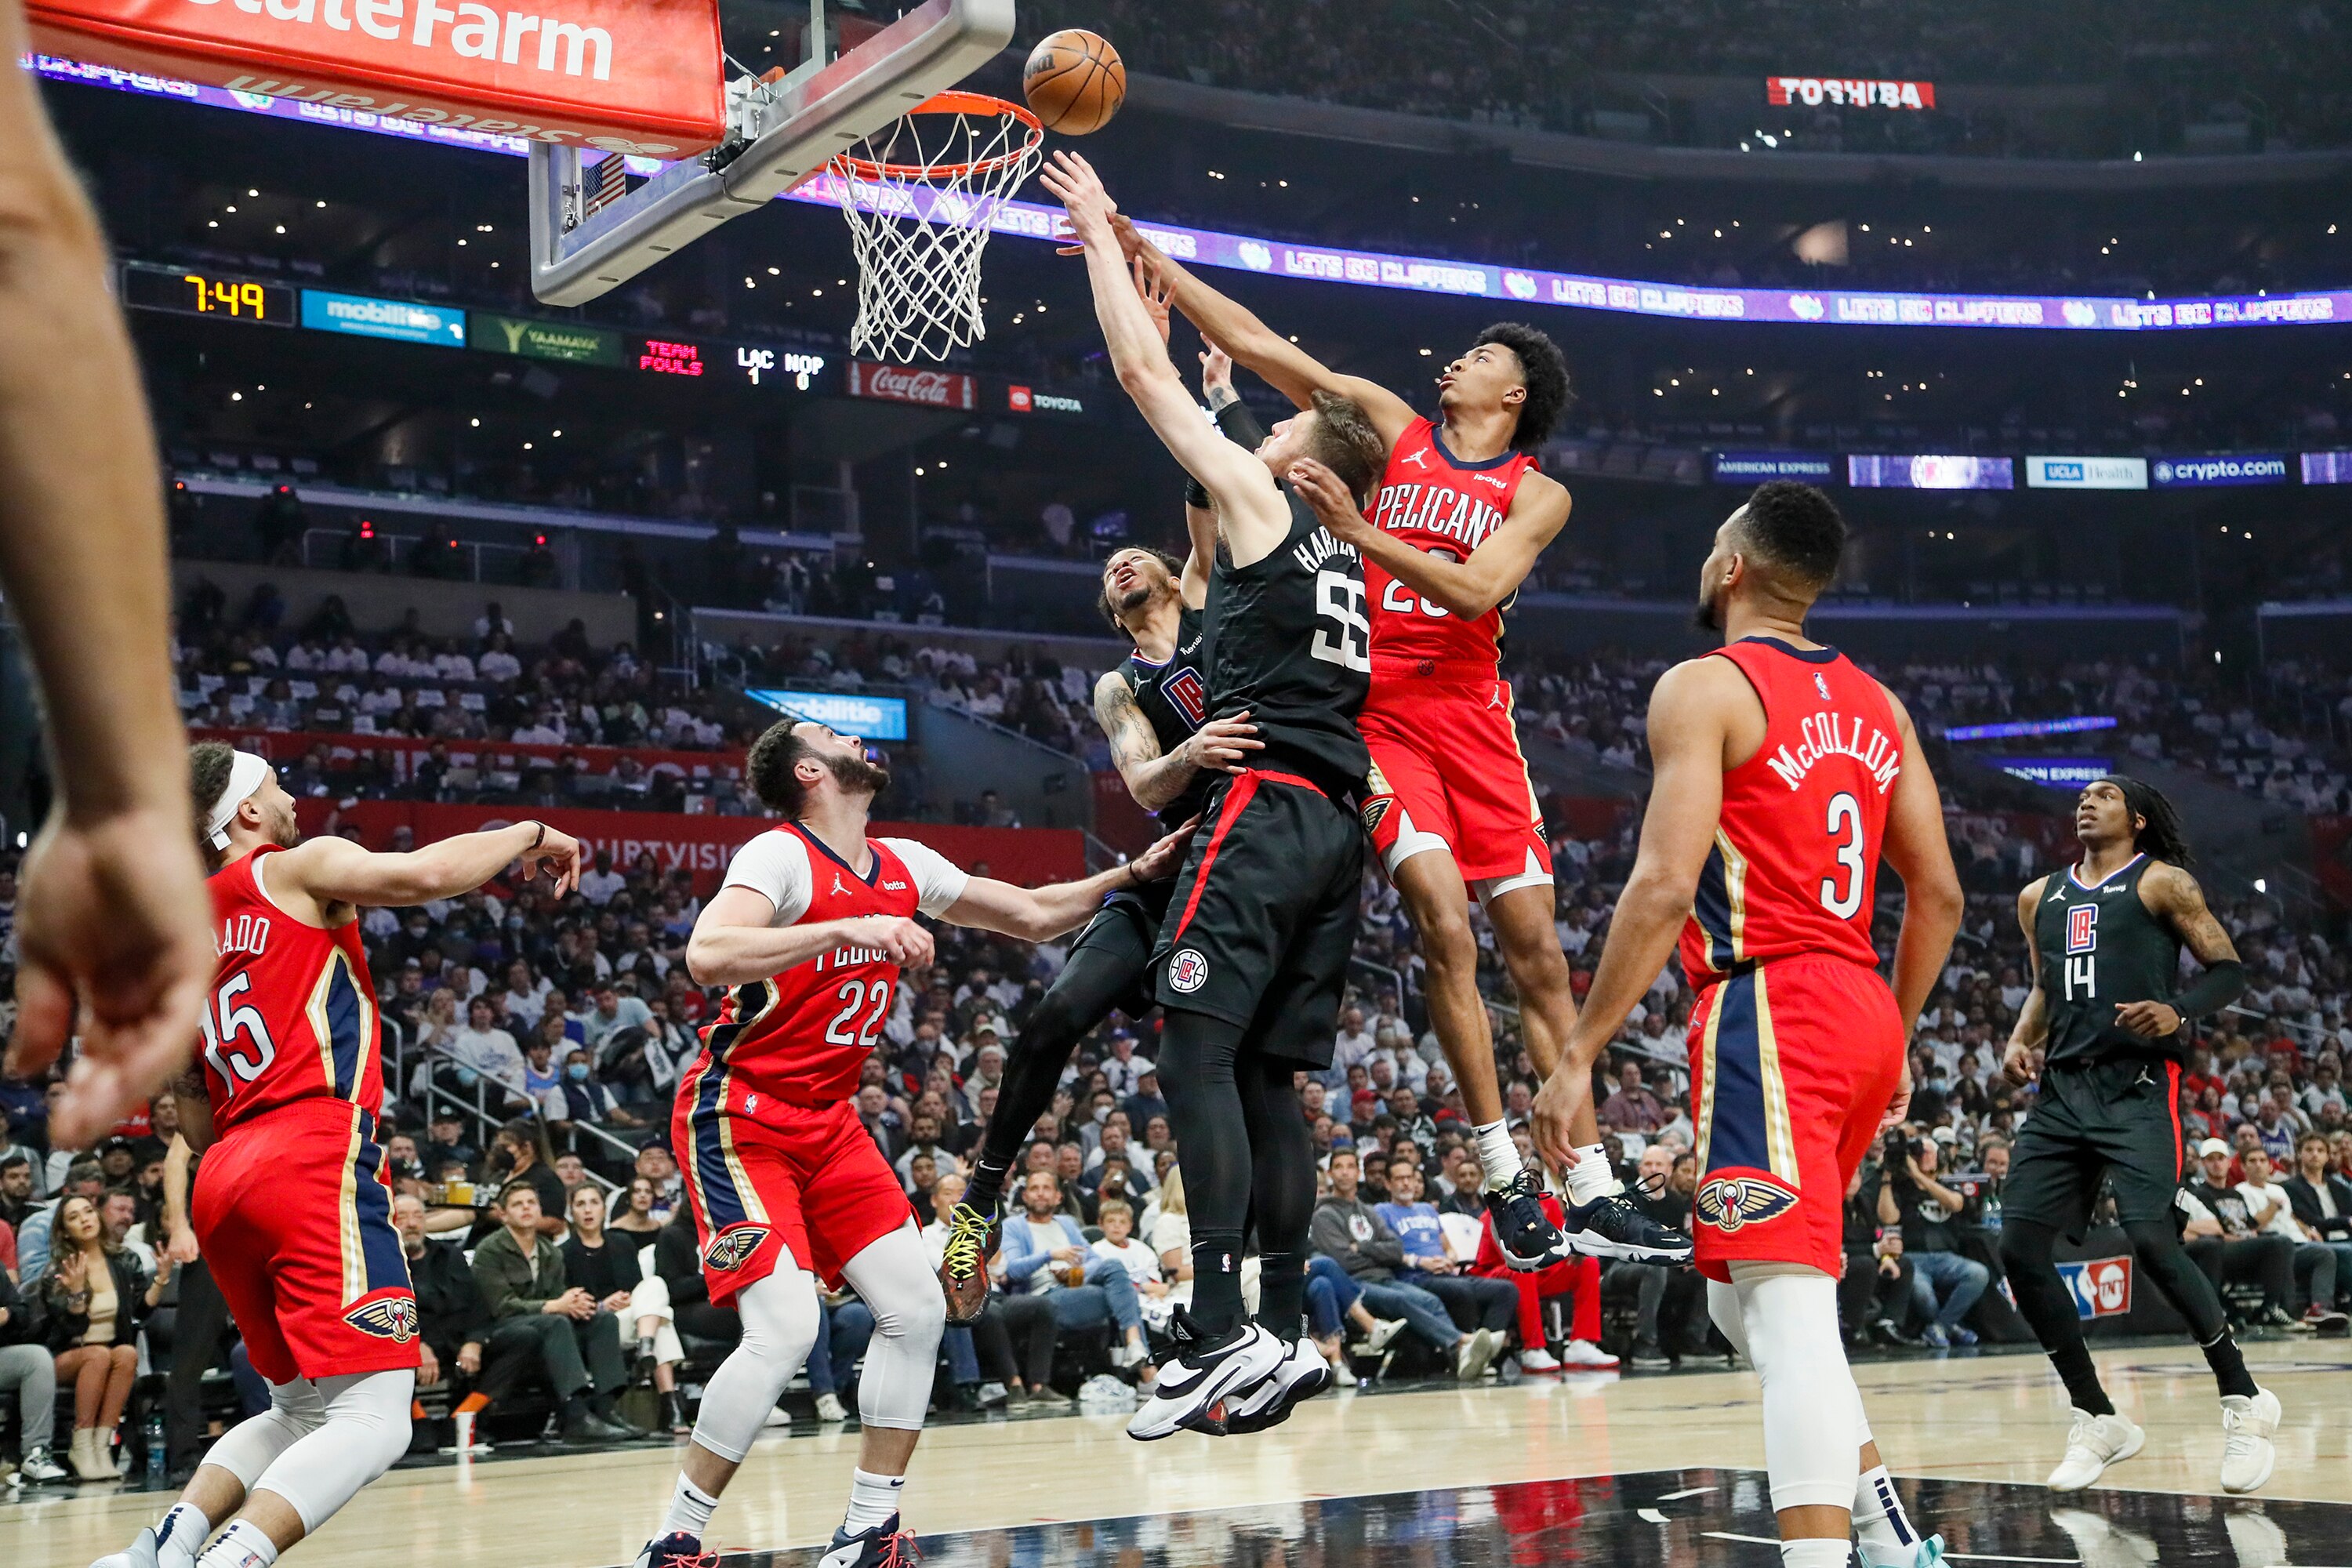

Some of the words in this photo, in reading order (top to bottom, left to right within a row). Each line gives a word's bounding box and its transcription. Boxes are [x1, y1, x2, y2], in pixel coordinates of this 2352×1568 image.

[1779, 78, 1922, 109] TOSHIBA
[184, 275, 264, 319] 7:49
[327, 300, 441, 331] mobilitie
[646, 339, 697, 360] TEAM
[738, 347, 775, 369] LAC
[785, 353, 825, 375] NOP
[640, 355, 703, 376] FOULS
[748, 366, 760, 385] 1
[1033, 394, 1083, 412] TOYOTA
[1717, 461, 1777, 474] AMERICAN
[1778, 462, 1831, 474] EXPRESS
[2049, 464, 2080, 480] UCLA
[2089, 465, 2133, 480] Health
[2175, 459, 2286, 481] crypto.com
[1310, 569, 1371, 674] 55
[1767, 711, 1900, 795] McCOLLUM
[2049, 767, 2108, 782] EXPRESS
[1820, 790, 1866, 920] 3
[2064, 955, 2096, 1001] 14
[825, 979, 891, 1047] 22
